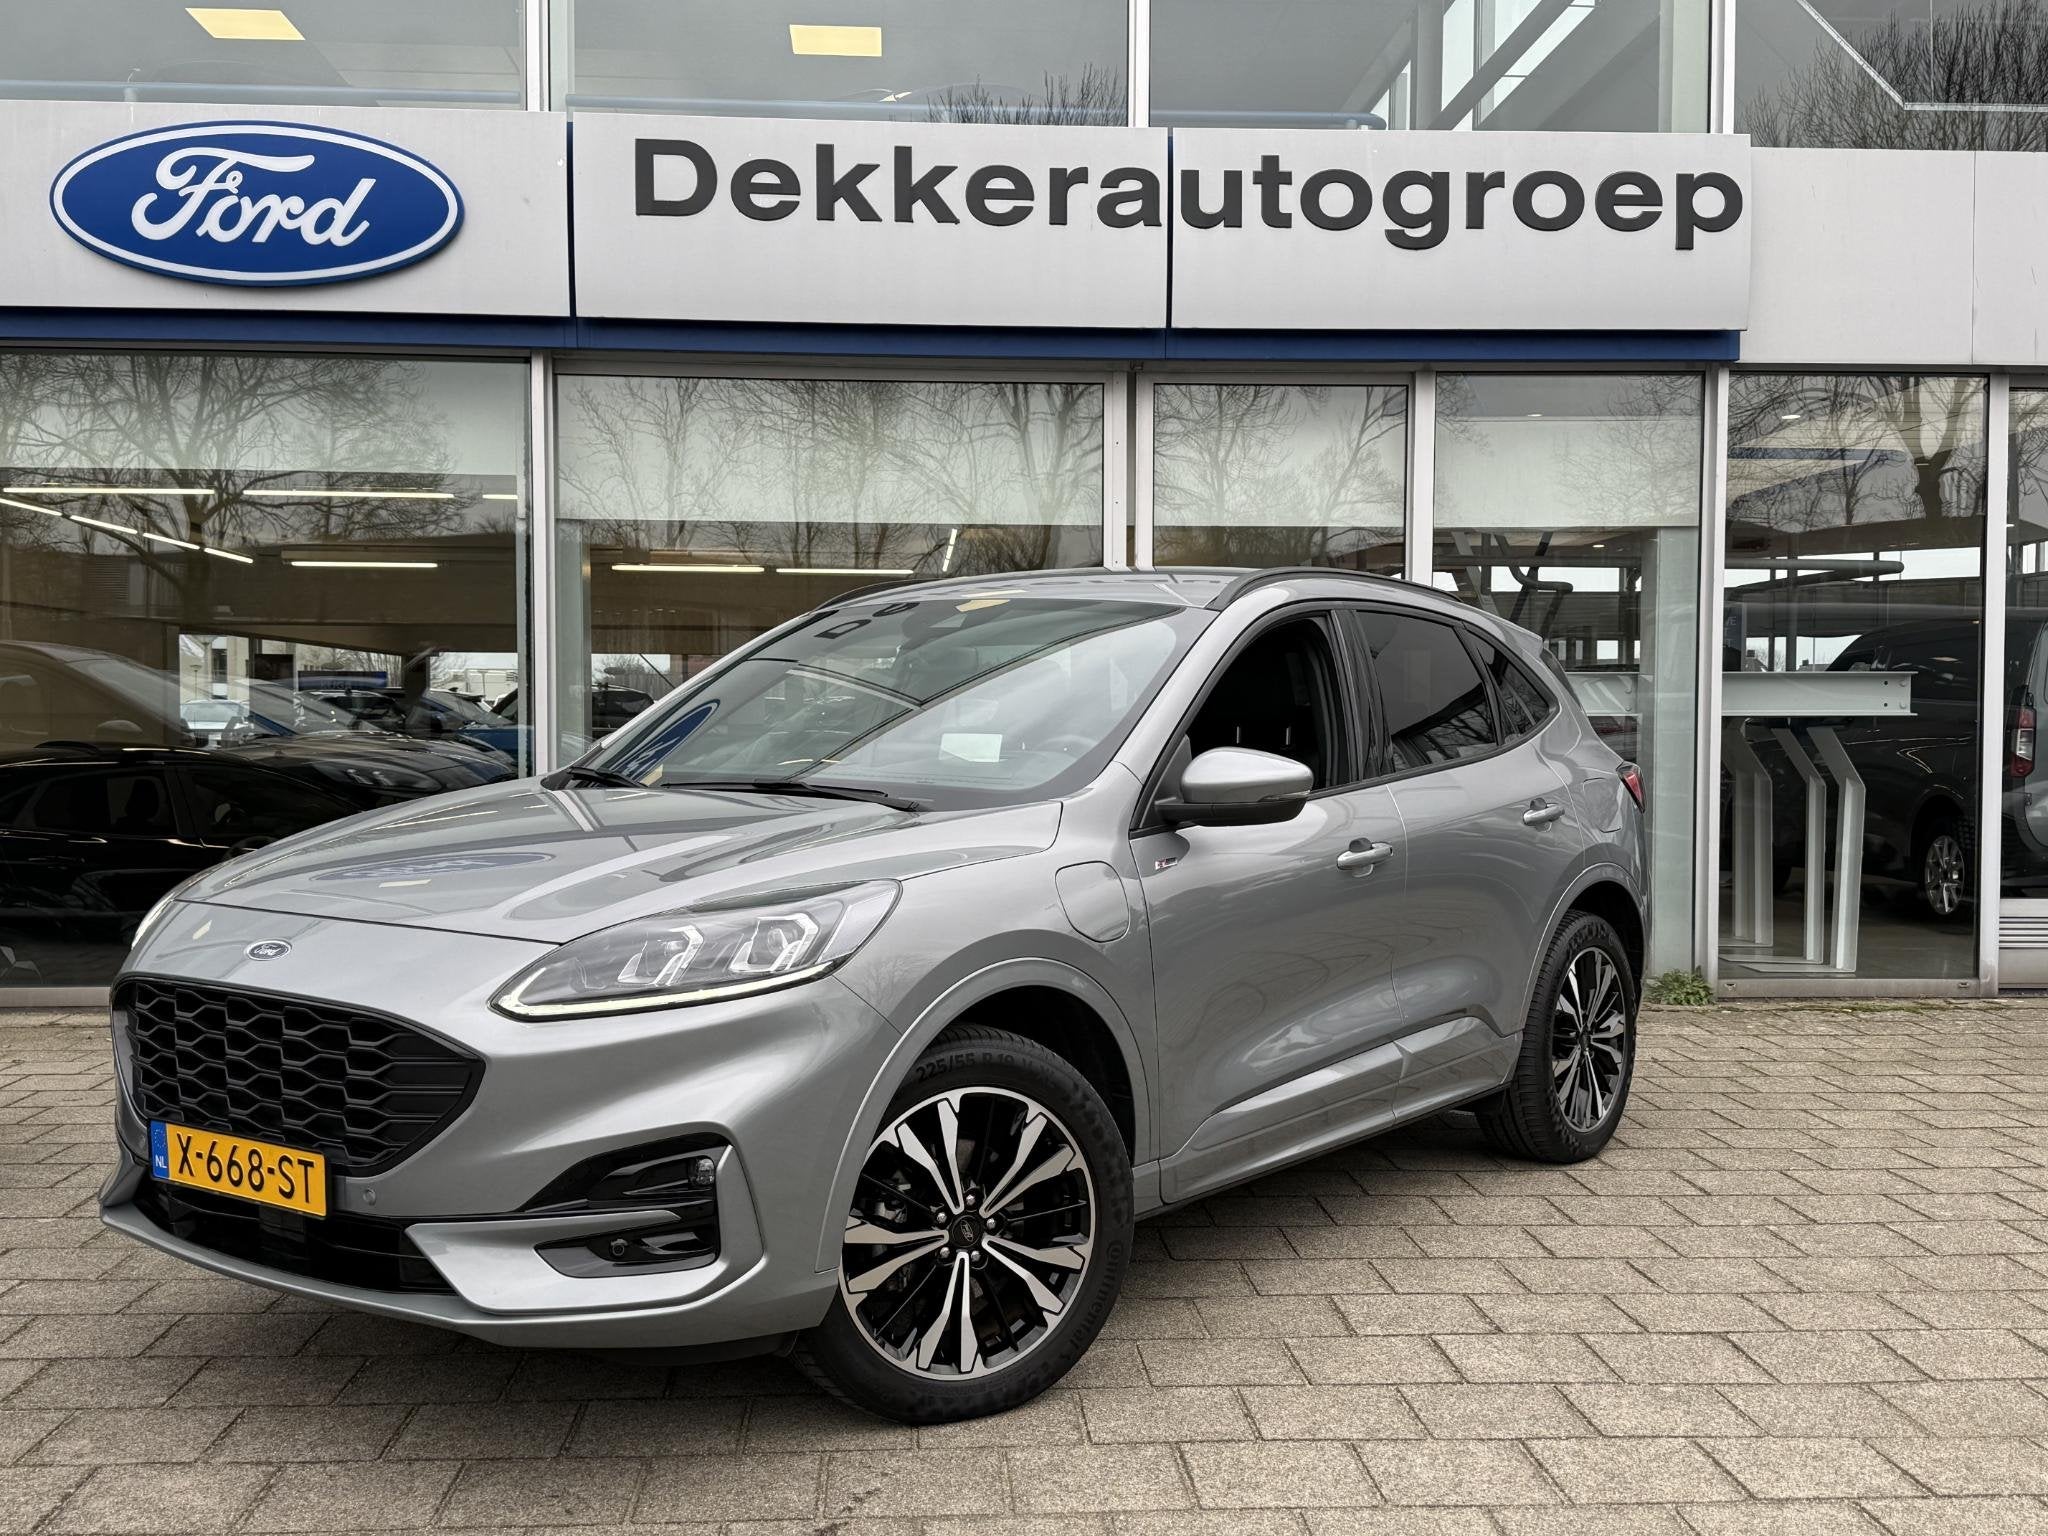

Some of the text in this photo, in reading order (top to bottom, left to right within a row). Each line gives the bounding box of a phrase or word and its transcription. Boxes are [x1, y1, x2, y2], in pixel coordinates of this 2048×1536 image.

[131, 146, 377, 248] Ford
[635, 137, 1744, 251] Dekkerautogroep
[915, 1052, 975, 1083] 225/55
[155, 1154, 168, 1169] NL
[176, 1133, 315, 1204] X-668-ST
